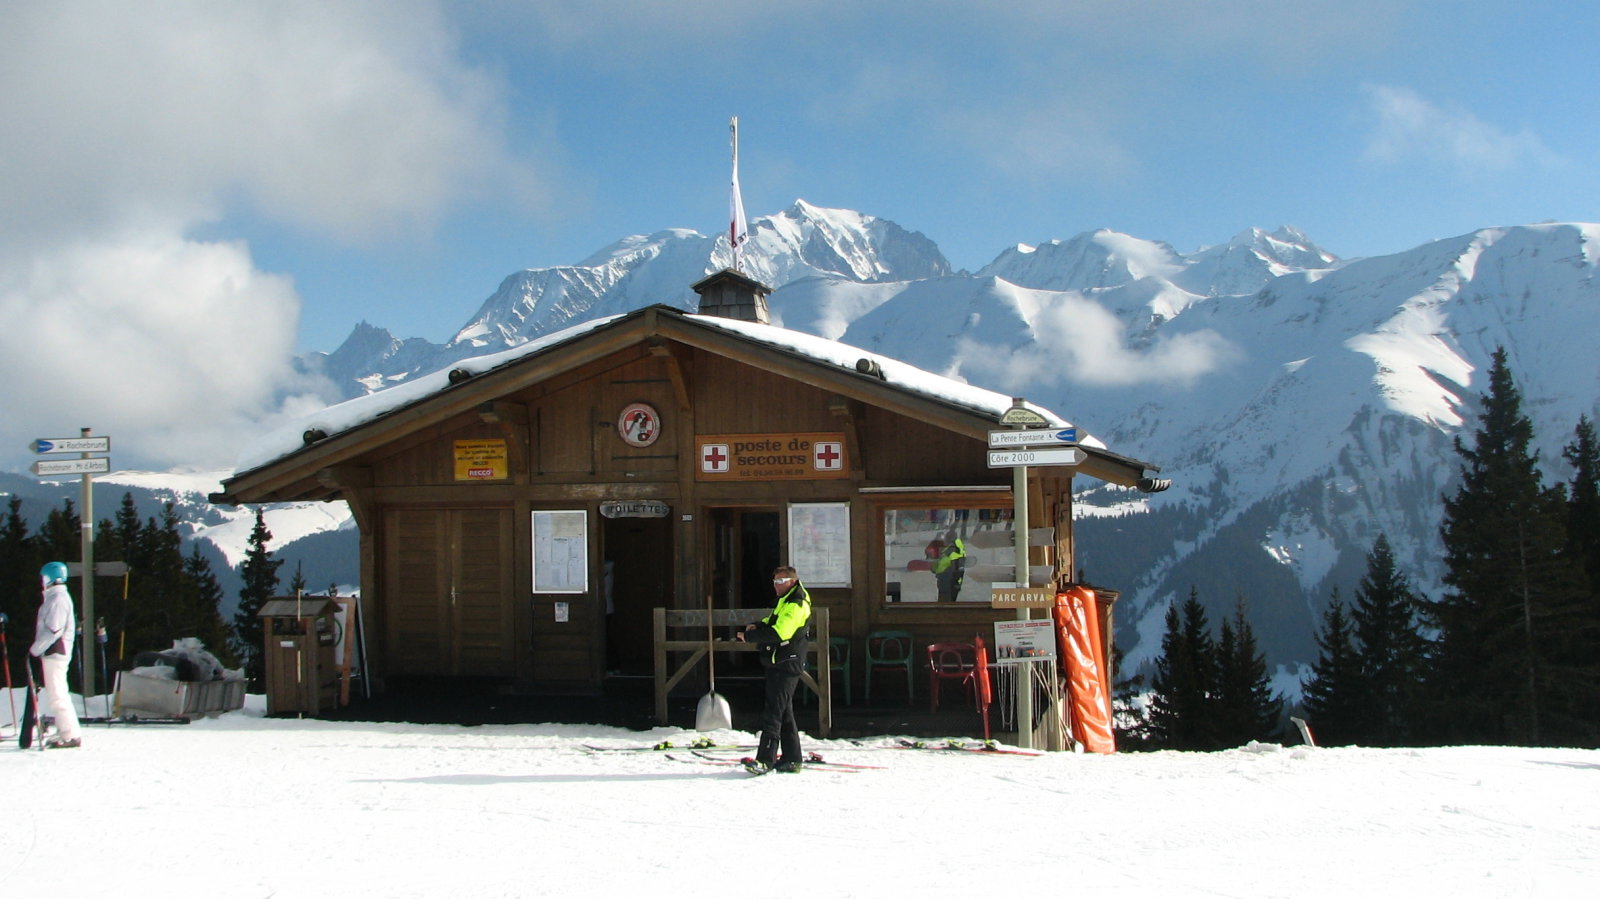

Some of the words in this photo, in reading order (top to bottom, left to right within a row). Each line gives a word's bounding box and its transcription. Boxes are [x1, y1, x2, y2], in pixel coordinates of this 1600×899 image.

[991, 435, 999, 443] La
[1018, 433, 1045, 441] Fontaine
[66, 441, 106, 449] Rochebrune
[734, 440, 782, 455] poste
[788, 438, 810, 451] de
[737, 455, 806, 466] secours
[991, 454, 1009, 463] Côte
[1012, 453, 1035, 462] 2000
[610, 504, 668, 514] TOILETTES
[992, 593, 1016, 602] PARC
[1020, 593, 1045, 602] ARVA
